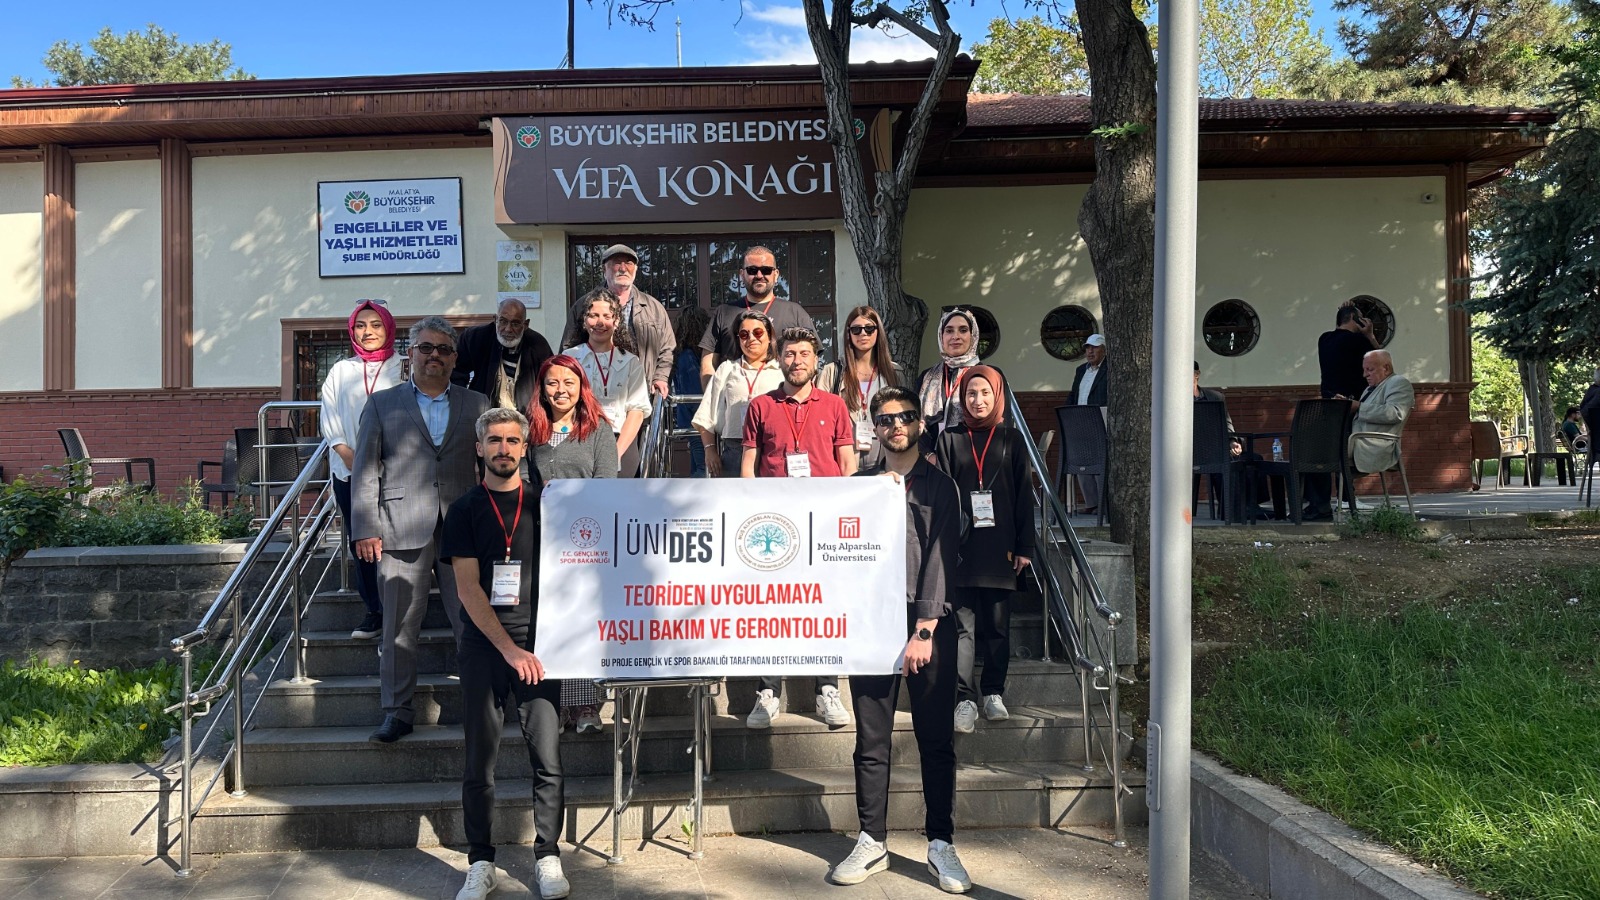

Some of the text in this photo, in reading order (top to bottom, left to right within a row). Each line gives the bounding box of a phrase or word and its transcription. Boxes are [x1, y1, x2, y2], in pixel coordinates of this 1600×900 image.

[552, 154, 833, 207] VEFA KONAĞI
[374, 196, 435, 206] BÜYÜKŞEHİR
[334, 220, 448, 234] ENGELLİLER VE
[324, 234, 458, 250] YAŞLI HİZMETLERİ
[342, 249, 440, 264] ŞUBE MÜDÜRLÜĞÜ
[818, 542, 882, 552] Muş Alparslan
[822, 552, 876, 562] Üniversitesi
[624, 581, 823, 606] TEORİDEN UYGULAMAYA
[598, 613, 847, 645] YAŞLI BAKIM VE GERONTOLOJİ
[601, 654, 843, 668] BU PROJE GENÇLİK VE SPOR BAKANLIĞI TARAFINDAN DESTEKLENMEKTEDİR
